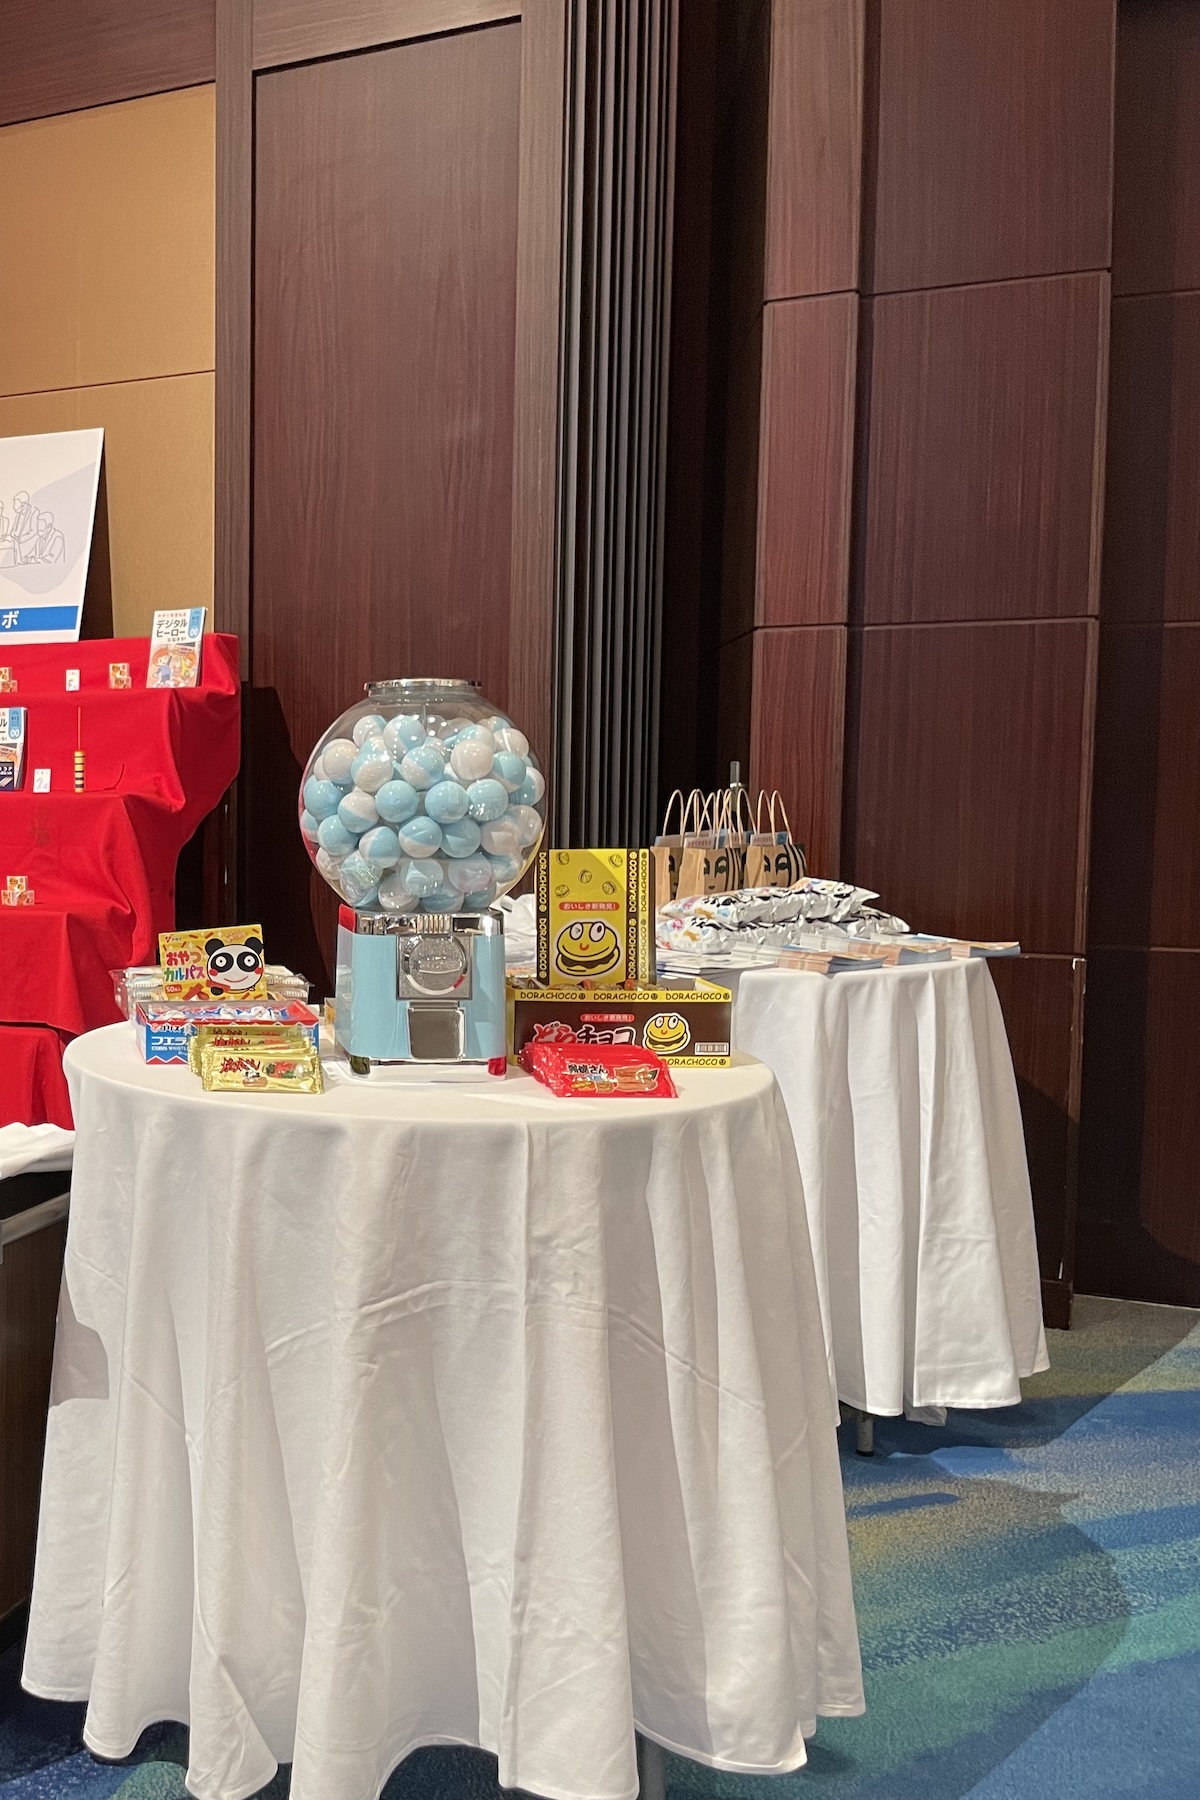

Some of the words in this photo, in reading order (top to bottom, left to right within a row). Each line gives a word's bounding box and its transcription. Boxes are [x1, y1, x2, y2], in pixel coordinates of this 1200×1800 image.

[156, 619, 188, 629] デジタル
[156, 629, 185, 638] ヒーロー
[539, 852, 547, 903] DORACHOCO
[629, 860, 638, 913] DORACHOCO
[539, 917, 547, 971] DORACHOCO
[166, 951, 202, 966] おやつ
[628, 926, 637, 979] DORACHOCO
[164, 966, 206, 982] カルパス
[520, 991, 578, 1000] DORACHOCO
[593, 992, 650, 1001] DORACHOCO
[665, 992, 721, 1001] DORACHOCO
[151, 1036, 189, 1046] フエラ
